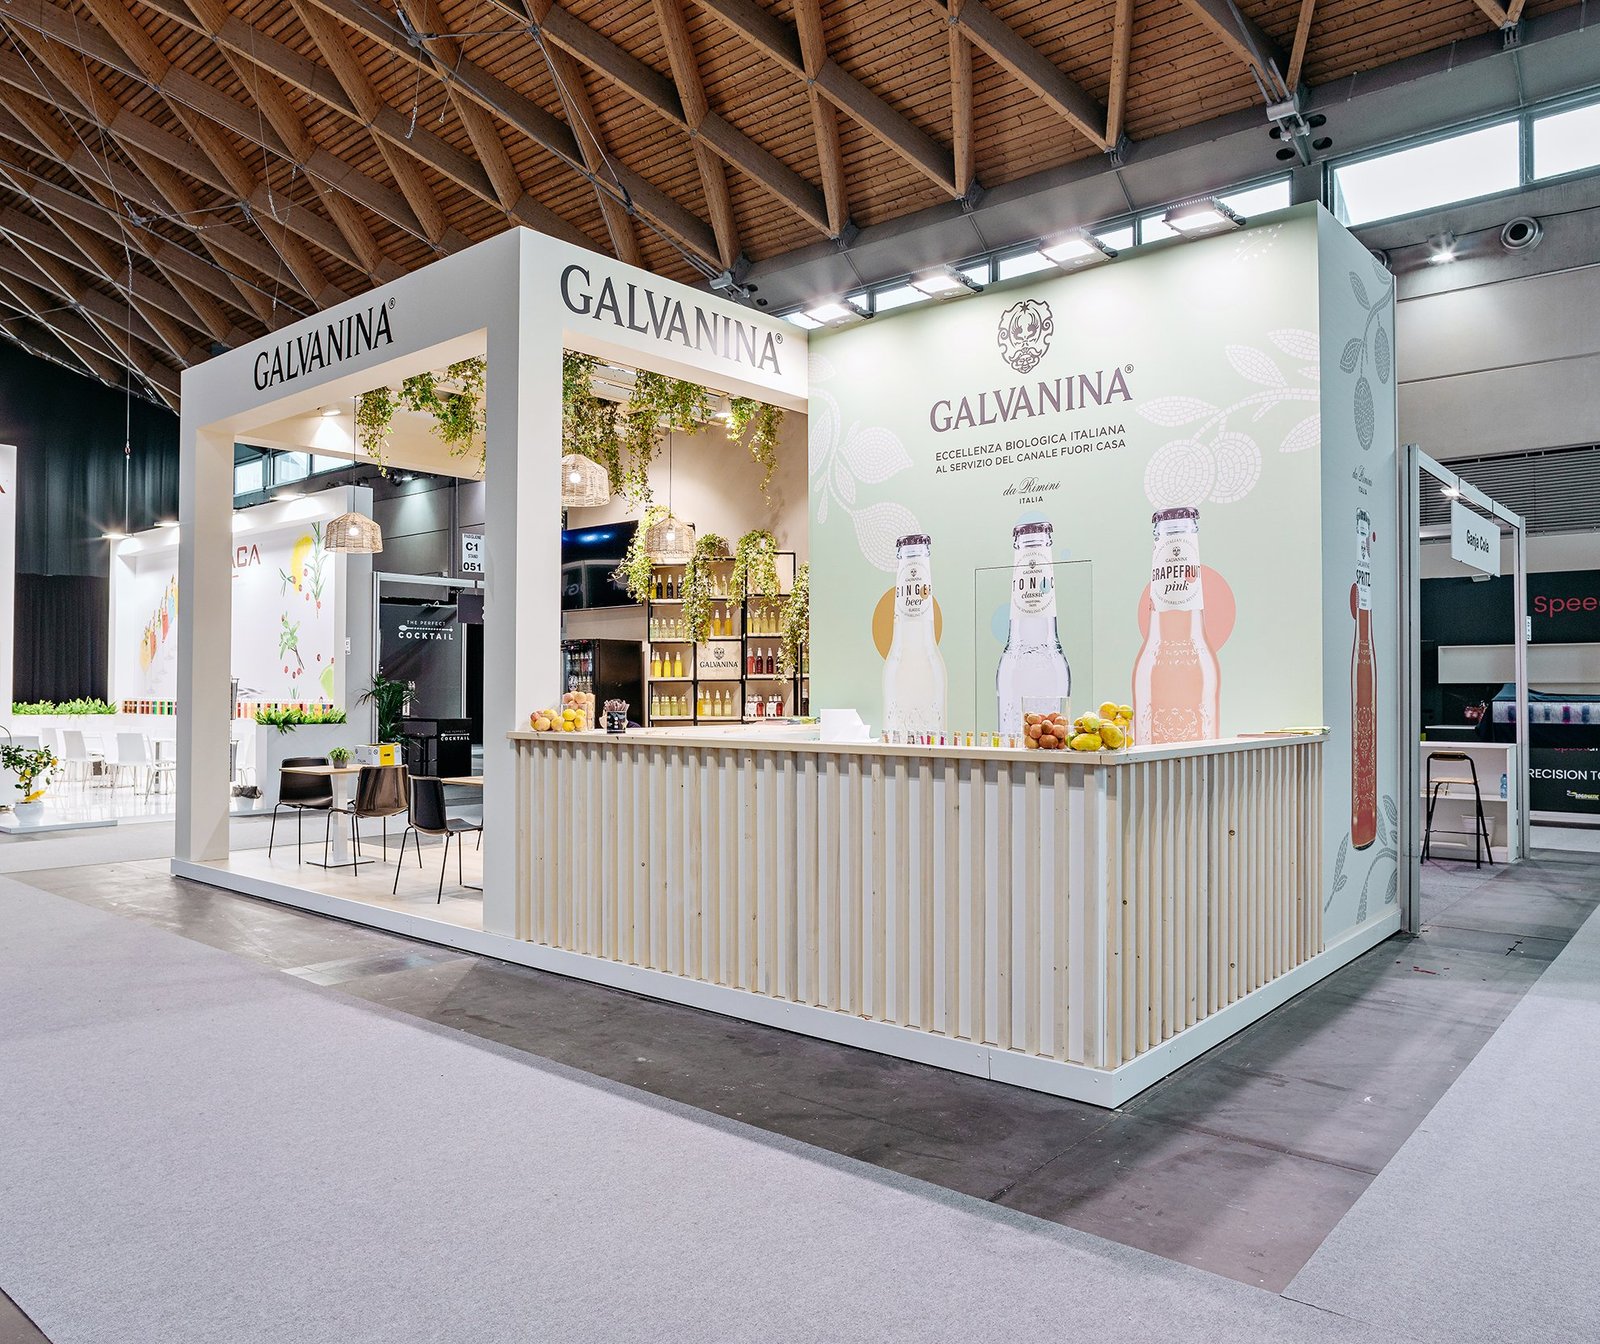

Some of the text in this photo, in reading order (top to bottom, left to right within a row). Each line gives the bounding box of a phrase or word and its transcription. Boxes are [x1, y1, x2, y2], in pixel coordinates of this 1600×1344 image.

[935, 424, 1126, 461] ECCELLENZA BIOLOGICA ITALIANA
[935, 439, 1126, 474] AL SERVIZIO DEL CANALE FUORI CASA
[1002, 476, 1061, 496] da Rimini
[1019, 495, 1044, 505] ITALIA
[465, 542, 479, 551] C1
[1480, 536, 1490, 553] Cola
[463, 562, 482, 571] 051
[1164, 580, 1189, 594] pink
[1021, 591, 1045, 599] classic
[905, 597, 924, 607] beer
[1534, 595, 1600, 619] Spee
[398, 631, 454, 640] COCKTAIL
[1529, 768, 1588, 780] RECISION
